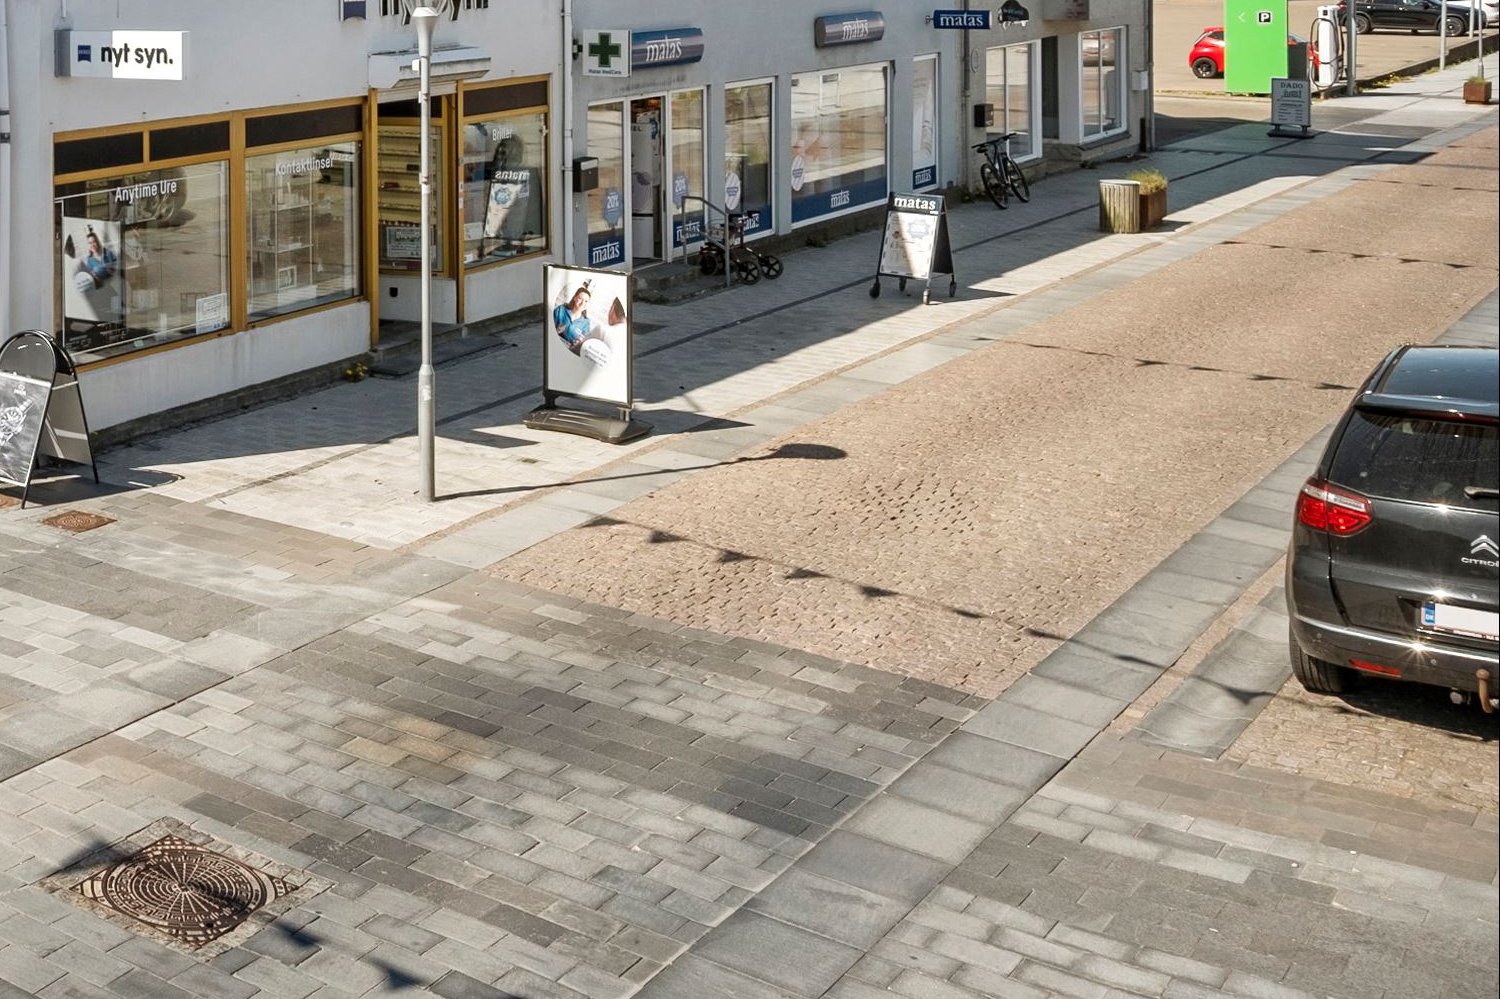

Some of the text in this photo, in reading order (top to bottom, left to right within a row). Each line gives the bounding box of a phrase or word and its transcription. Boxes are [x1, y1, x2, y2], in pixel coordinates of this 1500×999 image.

[842, 17, 869, 40] matas
[940, 12, 984, 27] matas
[101, 43, 174, 69] nyt syn.
[645, 34, 682, 62] matas
[492, 129, 512, 141] Briller
[275, 156, 334, 176] Kontaktlinser
[915, 168, 932, 186] matas
[114, 180, 177, 204] Anytime Ure
[830, 189, 850, 208] matas
[893, 197, 936, 210] matas
[592, 240, 620, 265] matas
